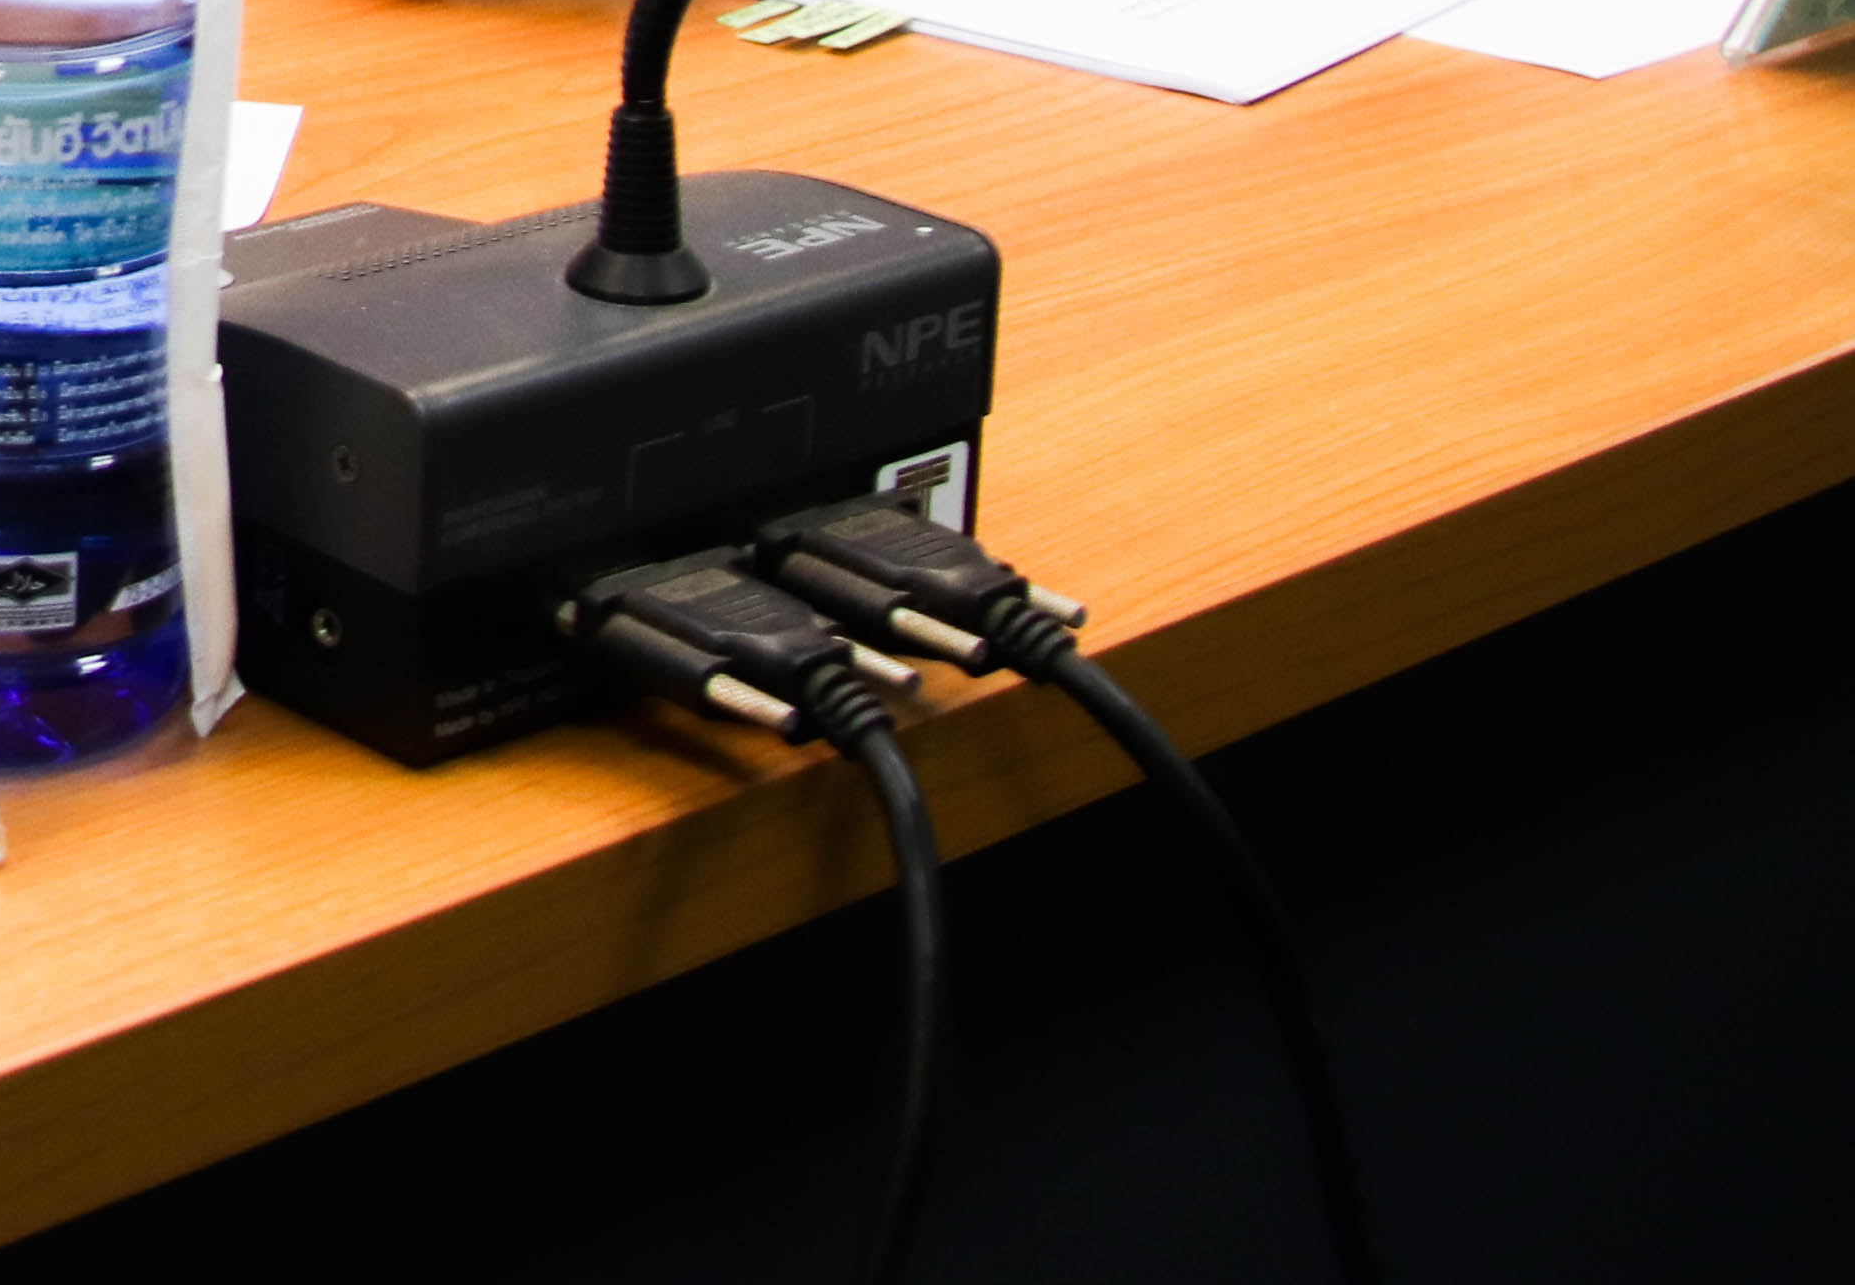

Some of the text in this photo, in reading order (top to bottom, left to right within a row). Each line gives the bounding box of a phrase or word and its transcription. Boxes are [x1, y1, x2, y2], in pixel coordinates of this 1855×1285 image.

[91, 99, 185, 158] วิตามิ
[736, 214, 887, 260] NPE
[862, 300, 986, 375] NPE
